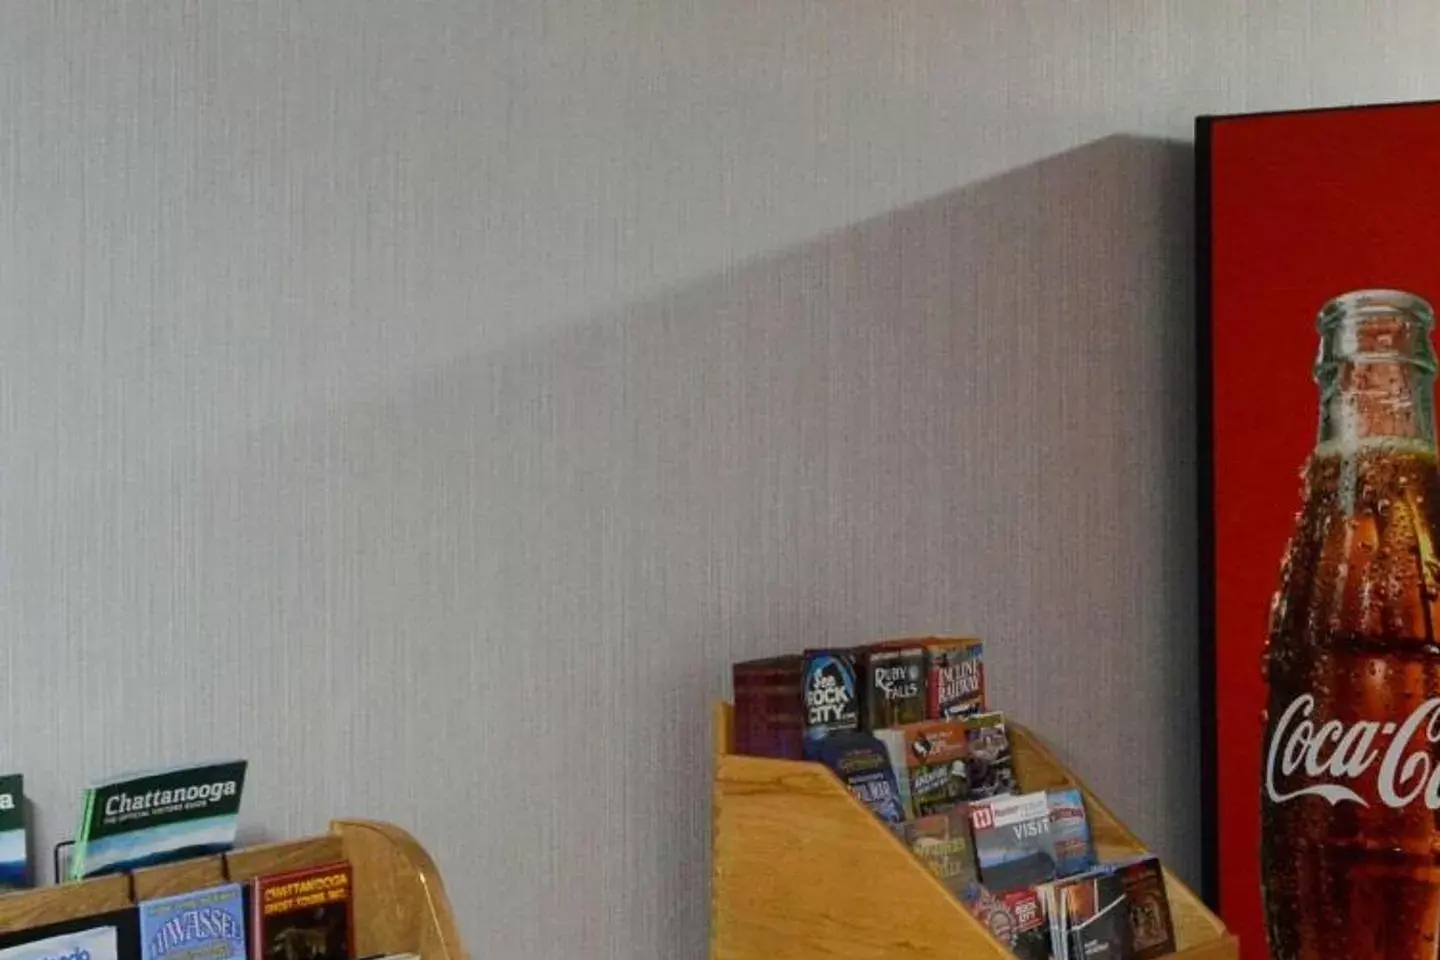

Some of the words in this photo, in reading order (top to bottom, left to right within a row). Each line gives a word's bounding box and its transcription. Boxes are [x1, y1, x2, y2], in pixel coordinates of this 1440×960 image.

[809, 705, 846, 725] CITY
[105, 779, 236, 817] Chattanooga
[1012, 819, 1050, 841] VISIT
